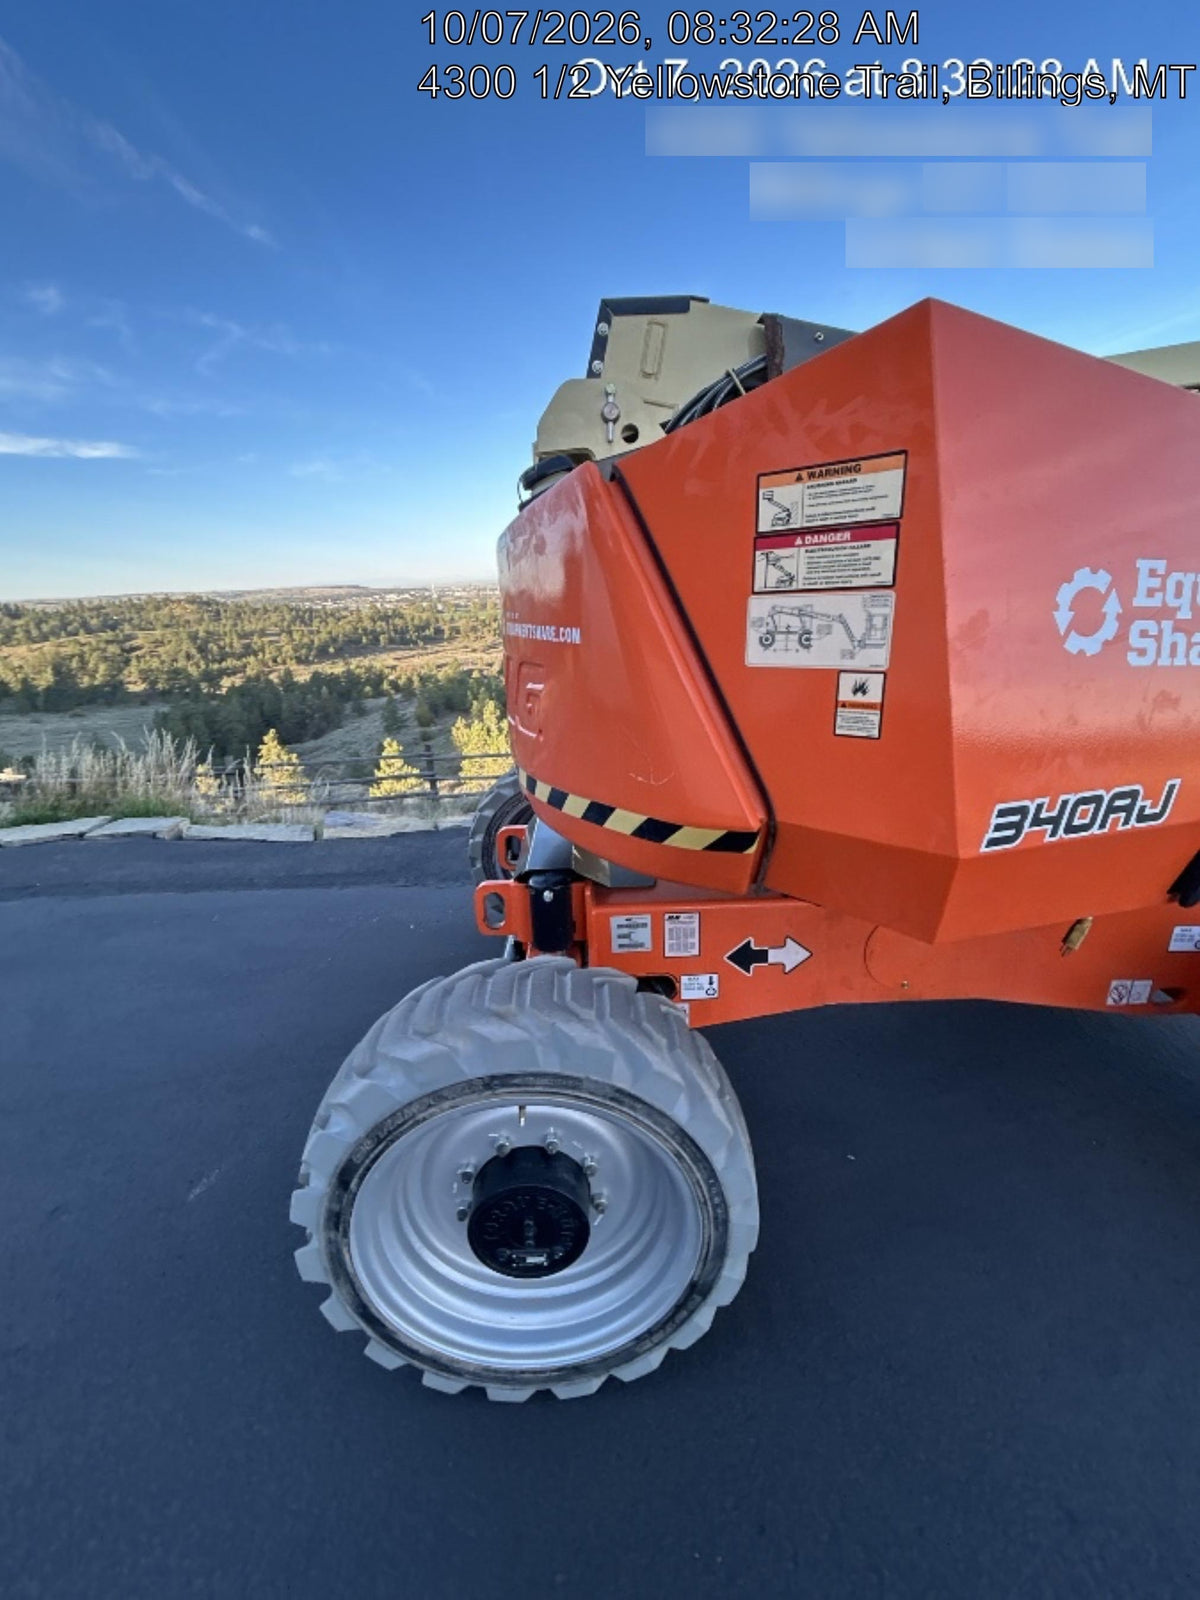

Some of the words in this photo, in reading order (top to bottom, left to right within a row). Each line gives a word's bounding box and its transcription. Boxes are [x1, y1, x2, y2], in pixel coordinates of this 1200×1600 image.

[806, 463, 862, 481] WARNING
[804, 532, 851, 545] DANGER
[1132, 558, 1200, 619] Eq
[979, 778, 1182, 852] 340AJ
